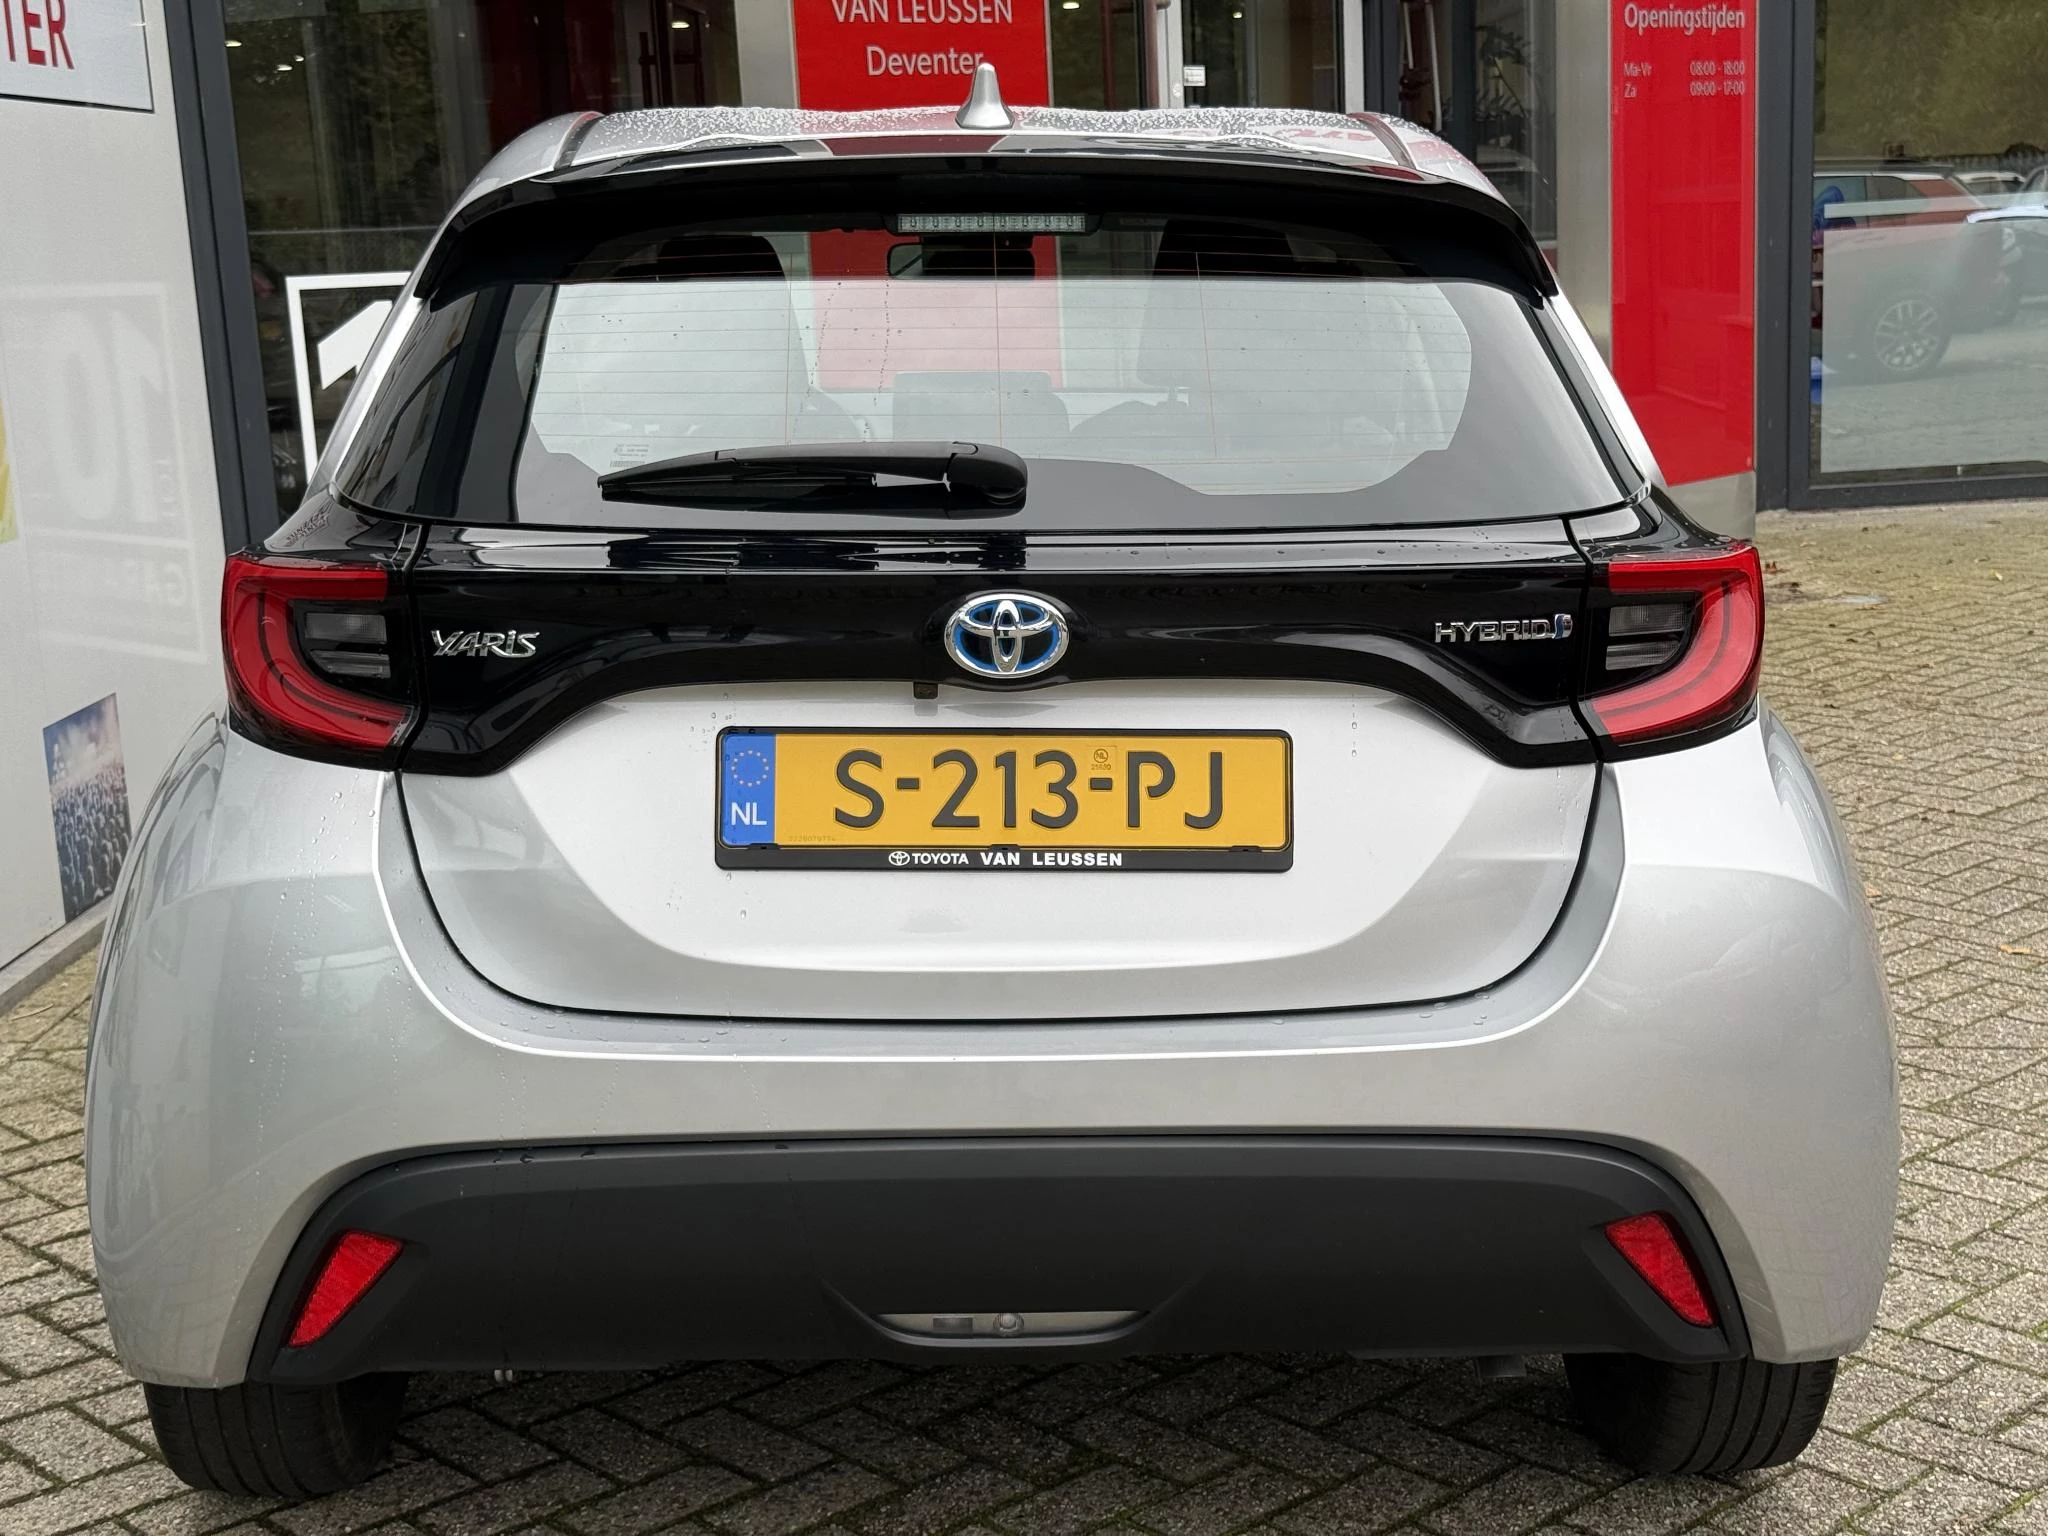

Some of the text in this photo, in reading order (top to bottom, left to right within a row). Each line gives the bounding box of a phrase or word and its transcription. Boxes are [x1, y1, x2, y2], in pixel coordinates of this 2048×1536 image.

[832, 0, 1013, 24] VAN LEUSSEN
[1624, 3, 1745, 36] Openingstijden
[1623, 83, 1637, 98] Za
[1434, 619, 1551, 643] HYBRID
[834, 749, 1223, 830] S-213-PJ
[730, 801, 768, 826] NL
[912, 852, 1123, 867] TOYOTA VAN LEUSSEN
